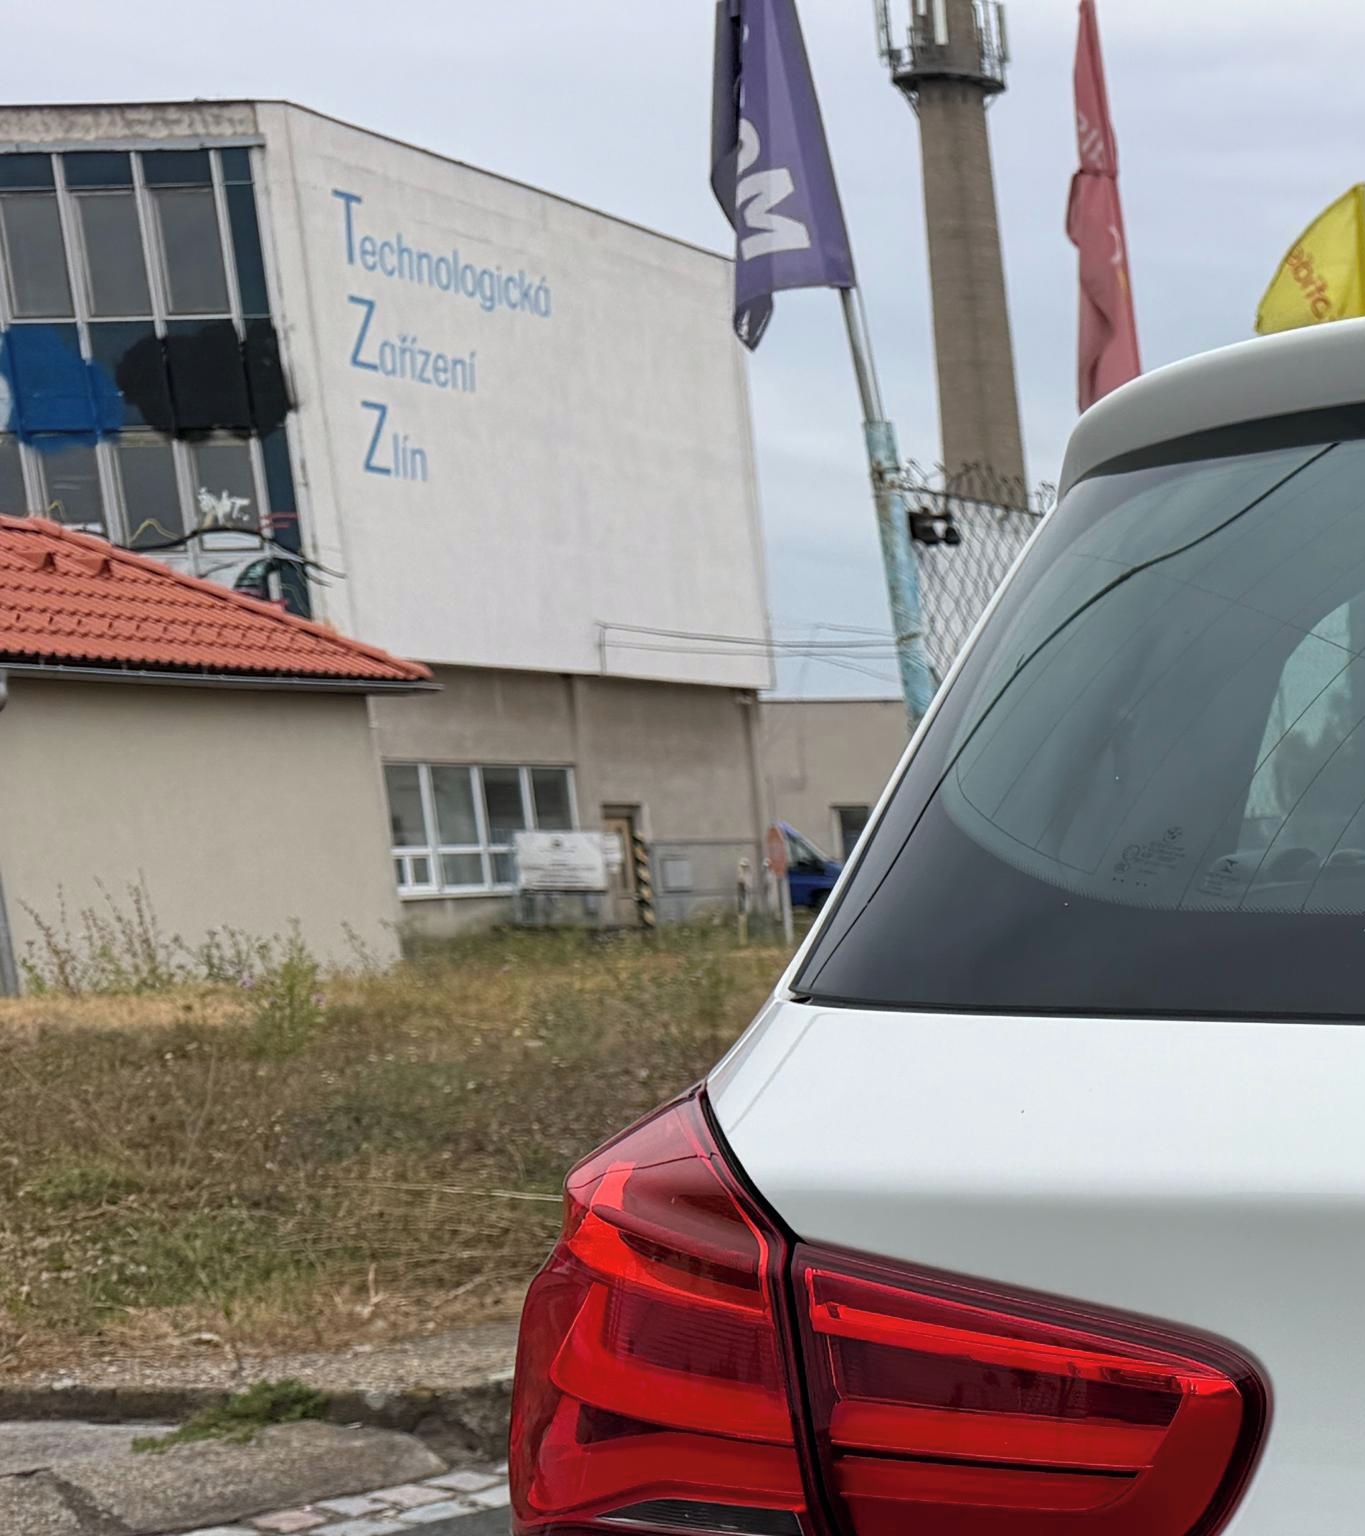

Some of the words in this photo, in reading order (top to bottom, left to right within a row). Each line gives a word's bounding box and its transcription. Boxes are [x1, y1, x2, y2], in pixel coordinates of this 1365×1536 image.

[330, 188, 552, 319] Technologická
[347, 294, 477, 392] Zařízení
[361, 400, 429, 482] Zlín
